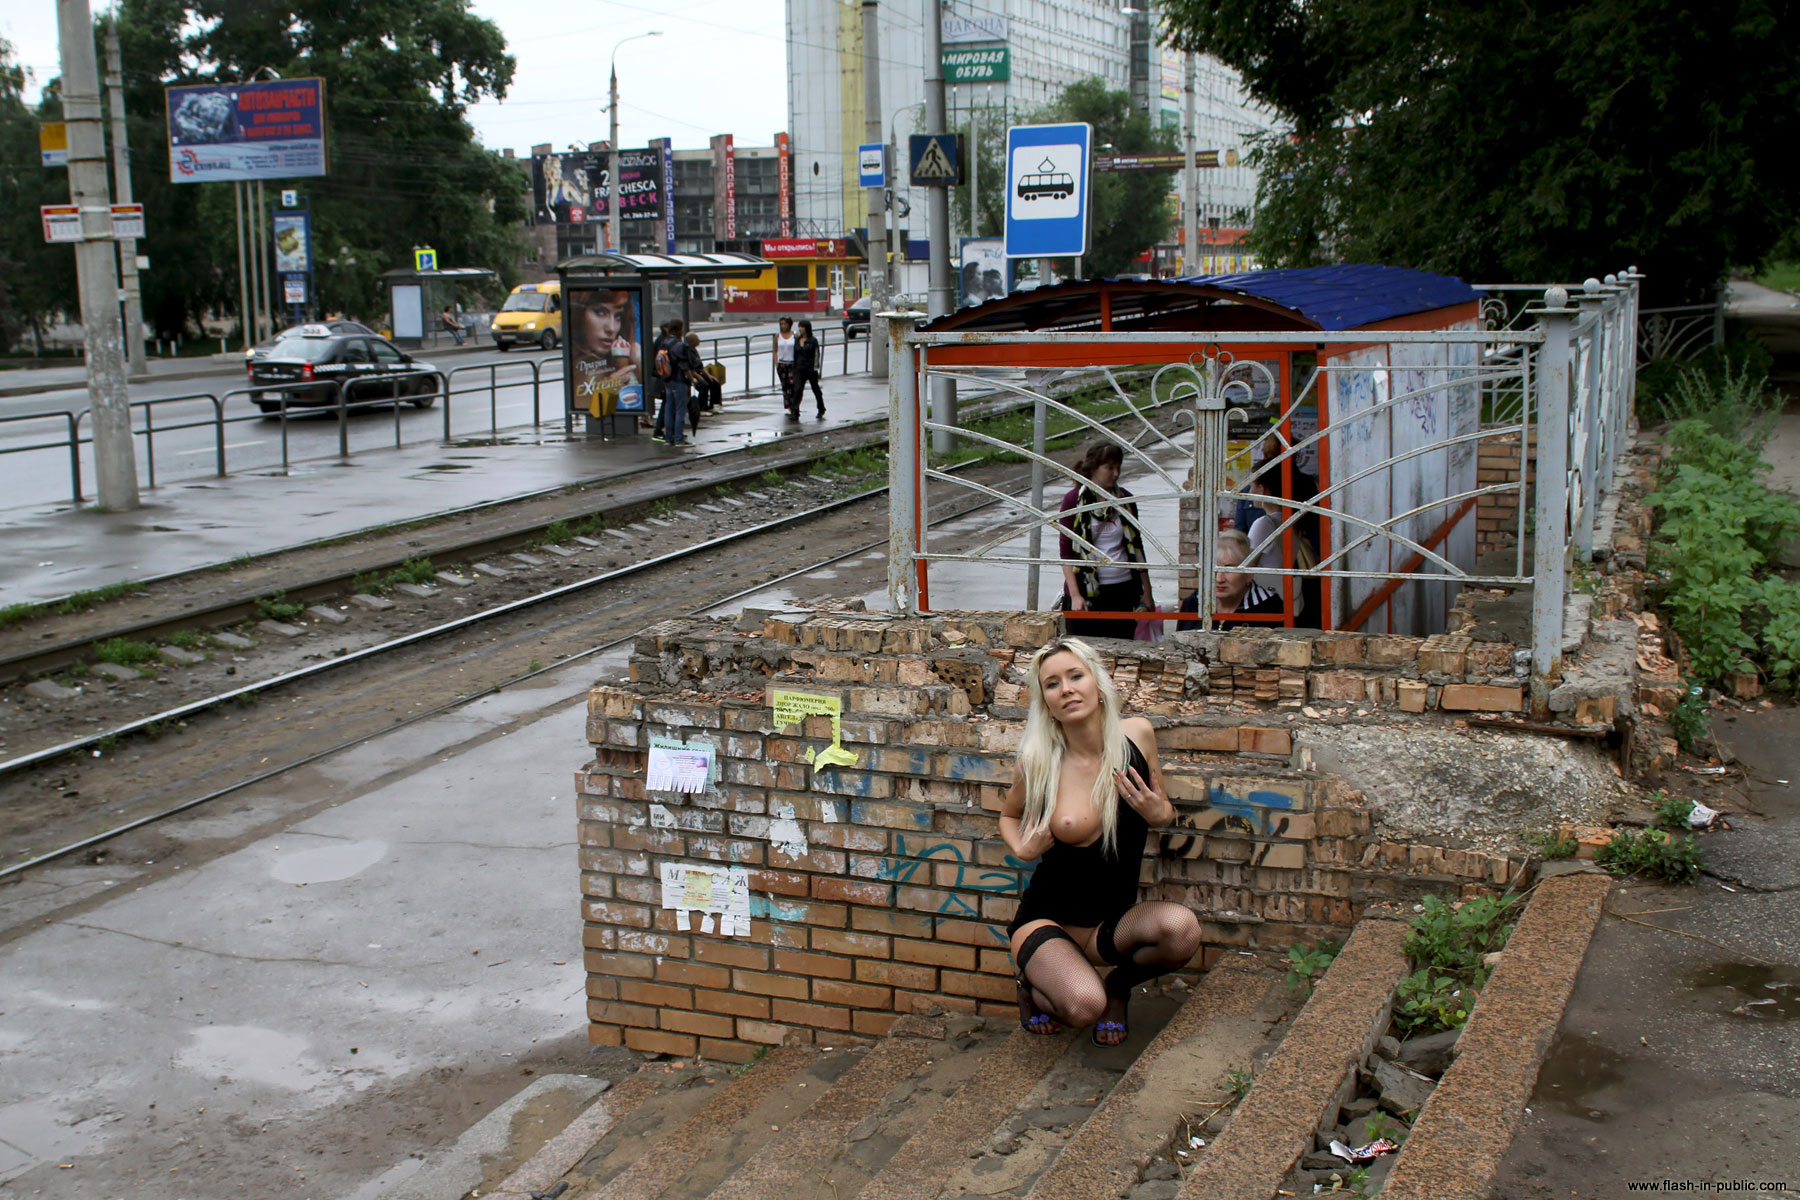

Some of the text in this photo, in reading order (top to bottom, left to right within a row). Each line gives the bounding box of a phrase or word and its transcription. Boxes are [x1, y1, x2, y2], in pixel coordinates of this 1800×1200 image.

[946, 50, 1005, 66] МИРОВАЯ
[955, 65, 994, 79] ОБУВЬ
[764, 244, 777, 252] Мы
